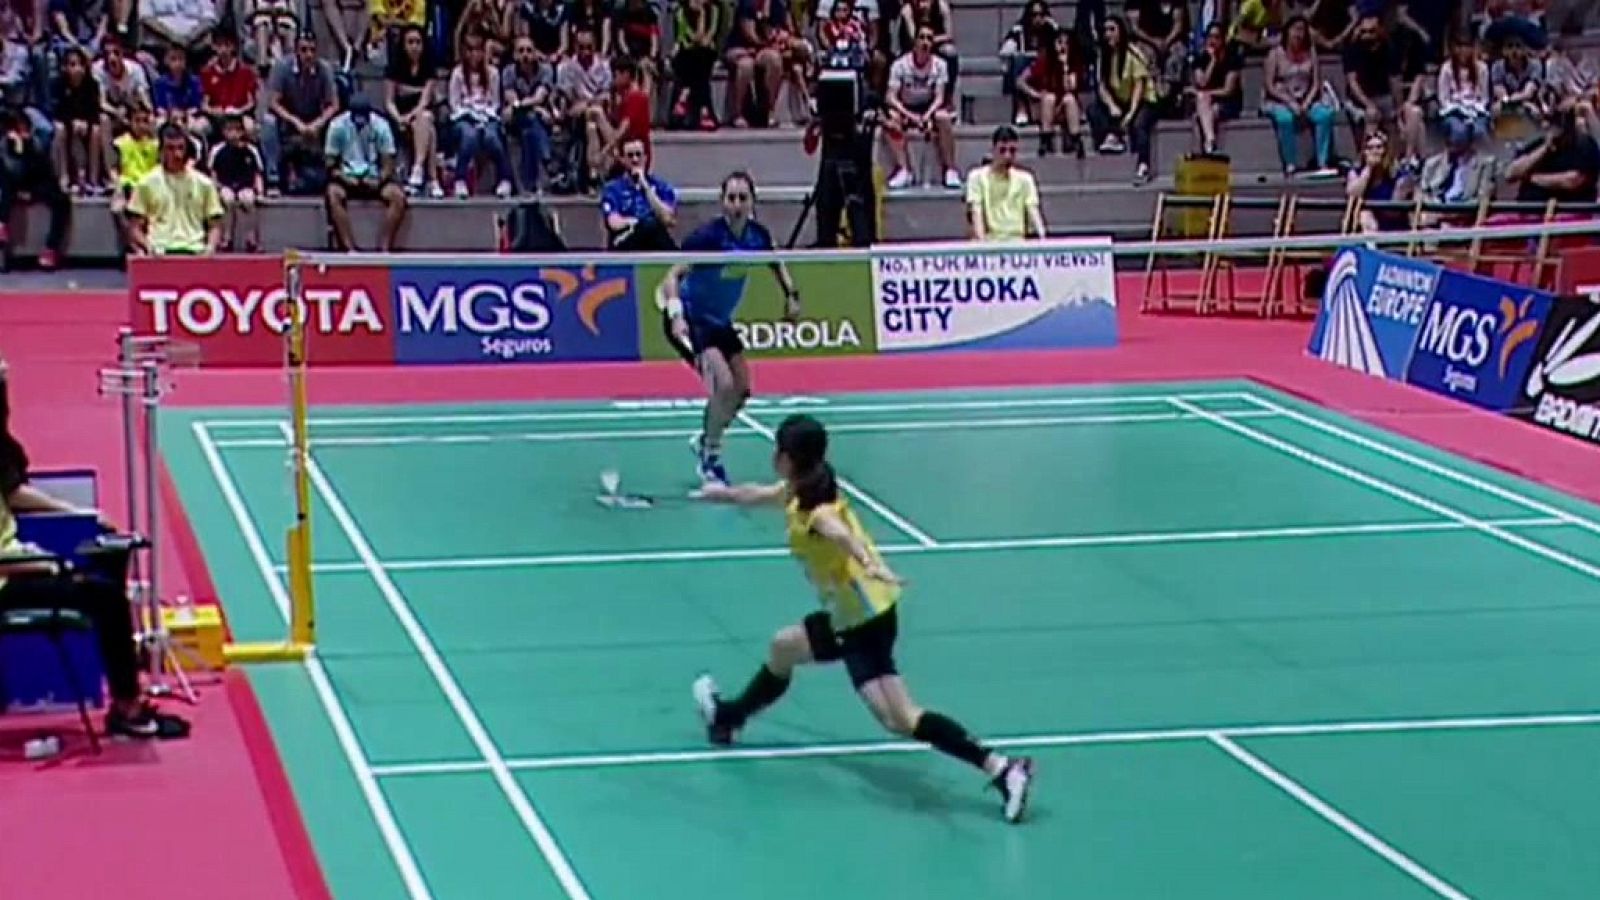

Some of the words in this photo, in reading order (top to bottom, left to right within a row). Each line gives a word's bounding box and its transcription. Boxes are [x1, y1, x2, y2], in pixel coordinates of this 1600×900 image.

[398, 282, 551, 334] MGS
[882, 276, 1040, 305] SHIZUOKA
[138, 288, 384, 334] TOYOTA
[884, 305, 952, 332] CITY
[480, 335, 552, 359] Seguros
[1419, 301, 1497, 367] MGS
